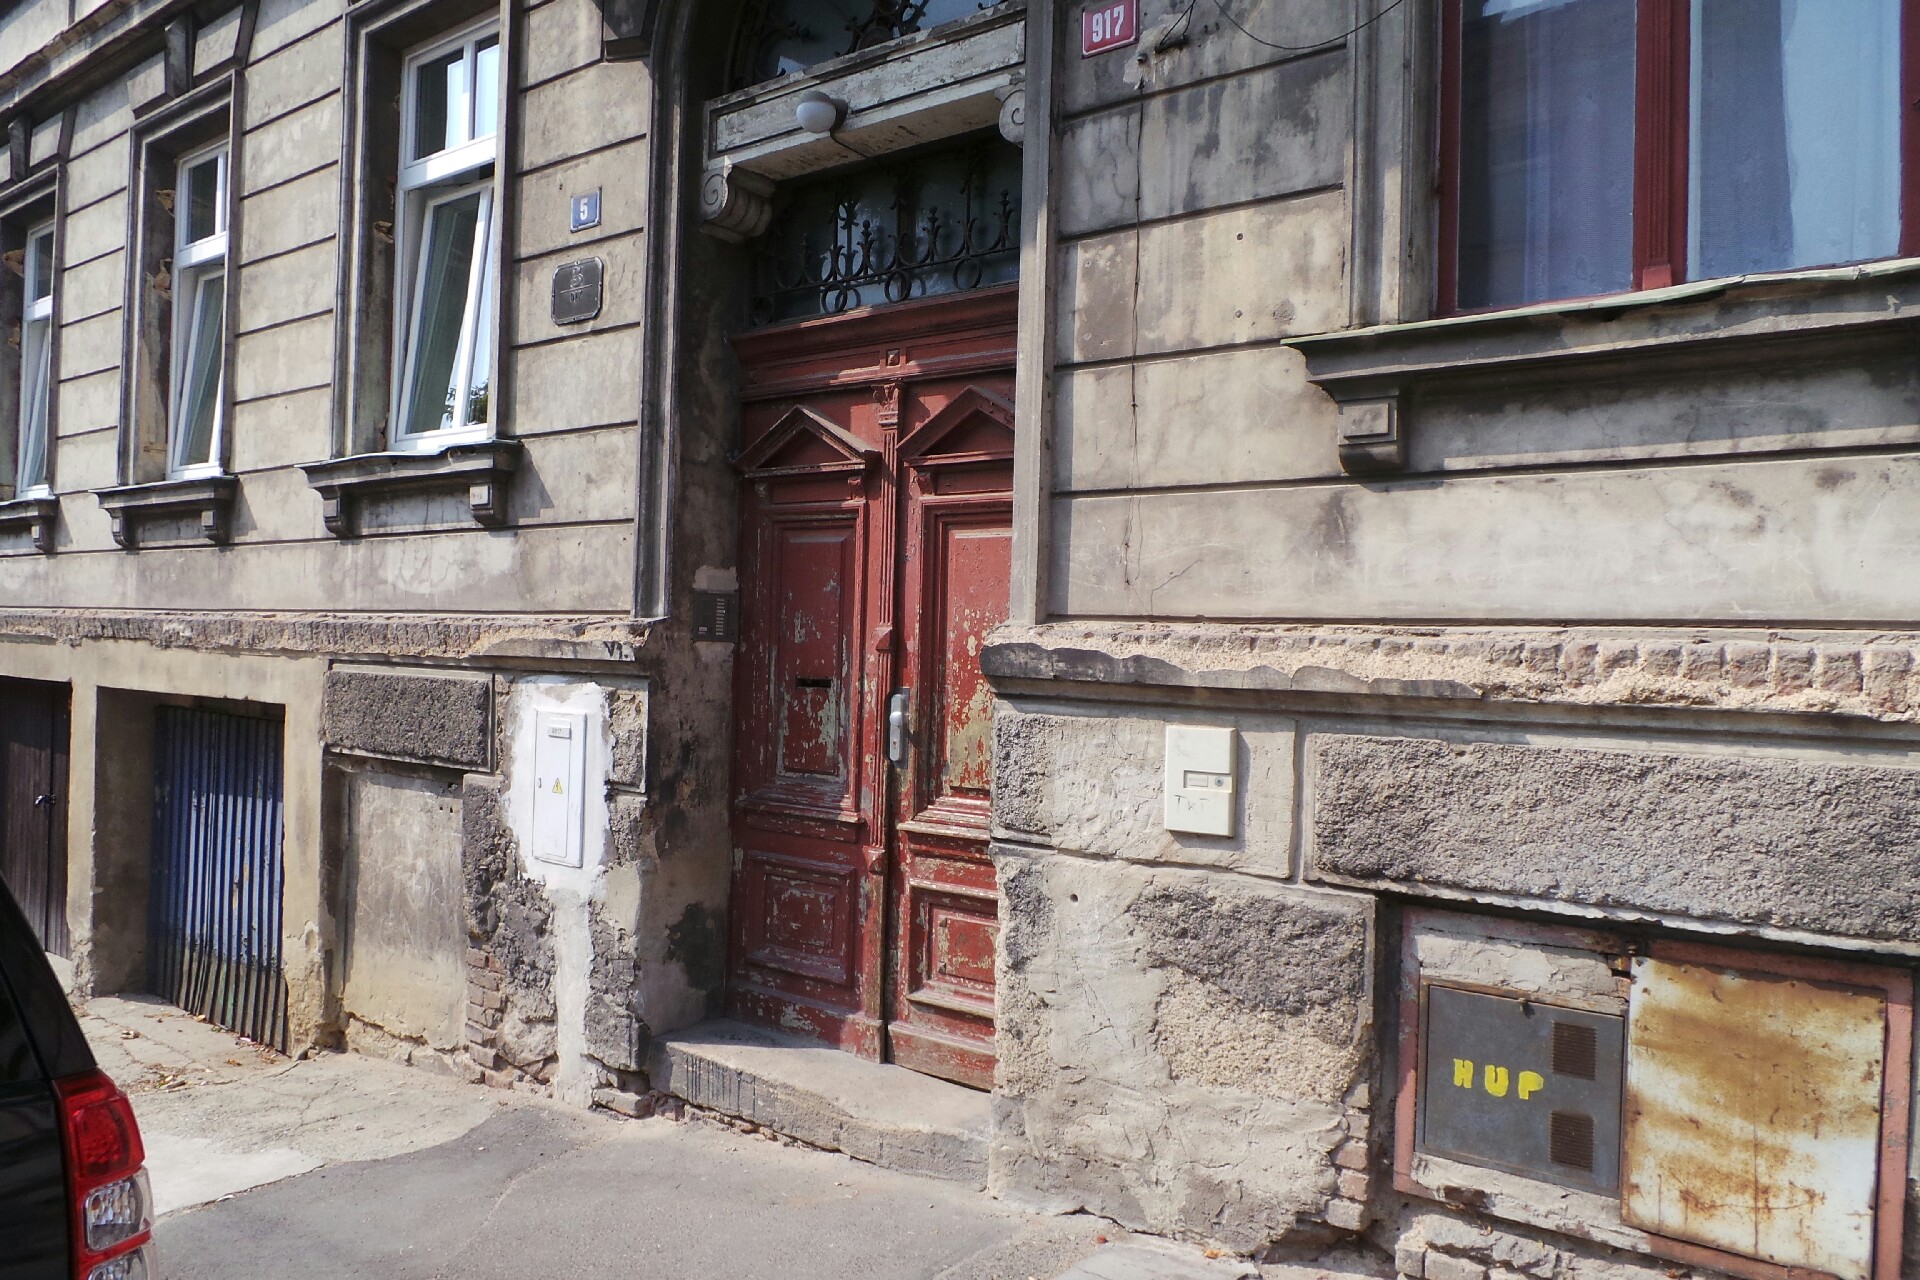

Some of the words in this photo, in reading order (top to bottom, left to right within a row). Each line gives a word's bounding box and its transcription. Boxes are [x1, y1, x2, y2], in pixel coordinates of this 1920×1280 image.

[1092, 4, 1125, 43] 917
[579, 197, 589, 221] 5
[1452, 1057, 1545, 1101] HUP
